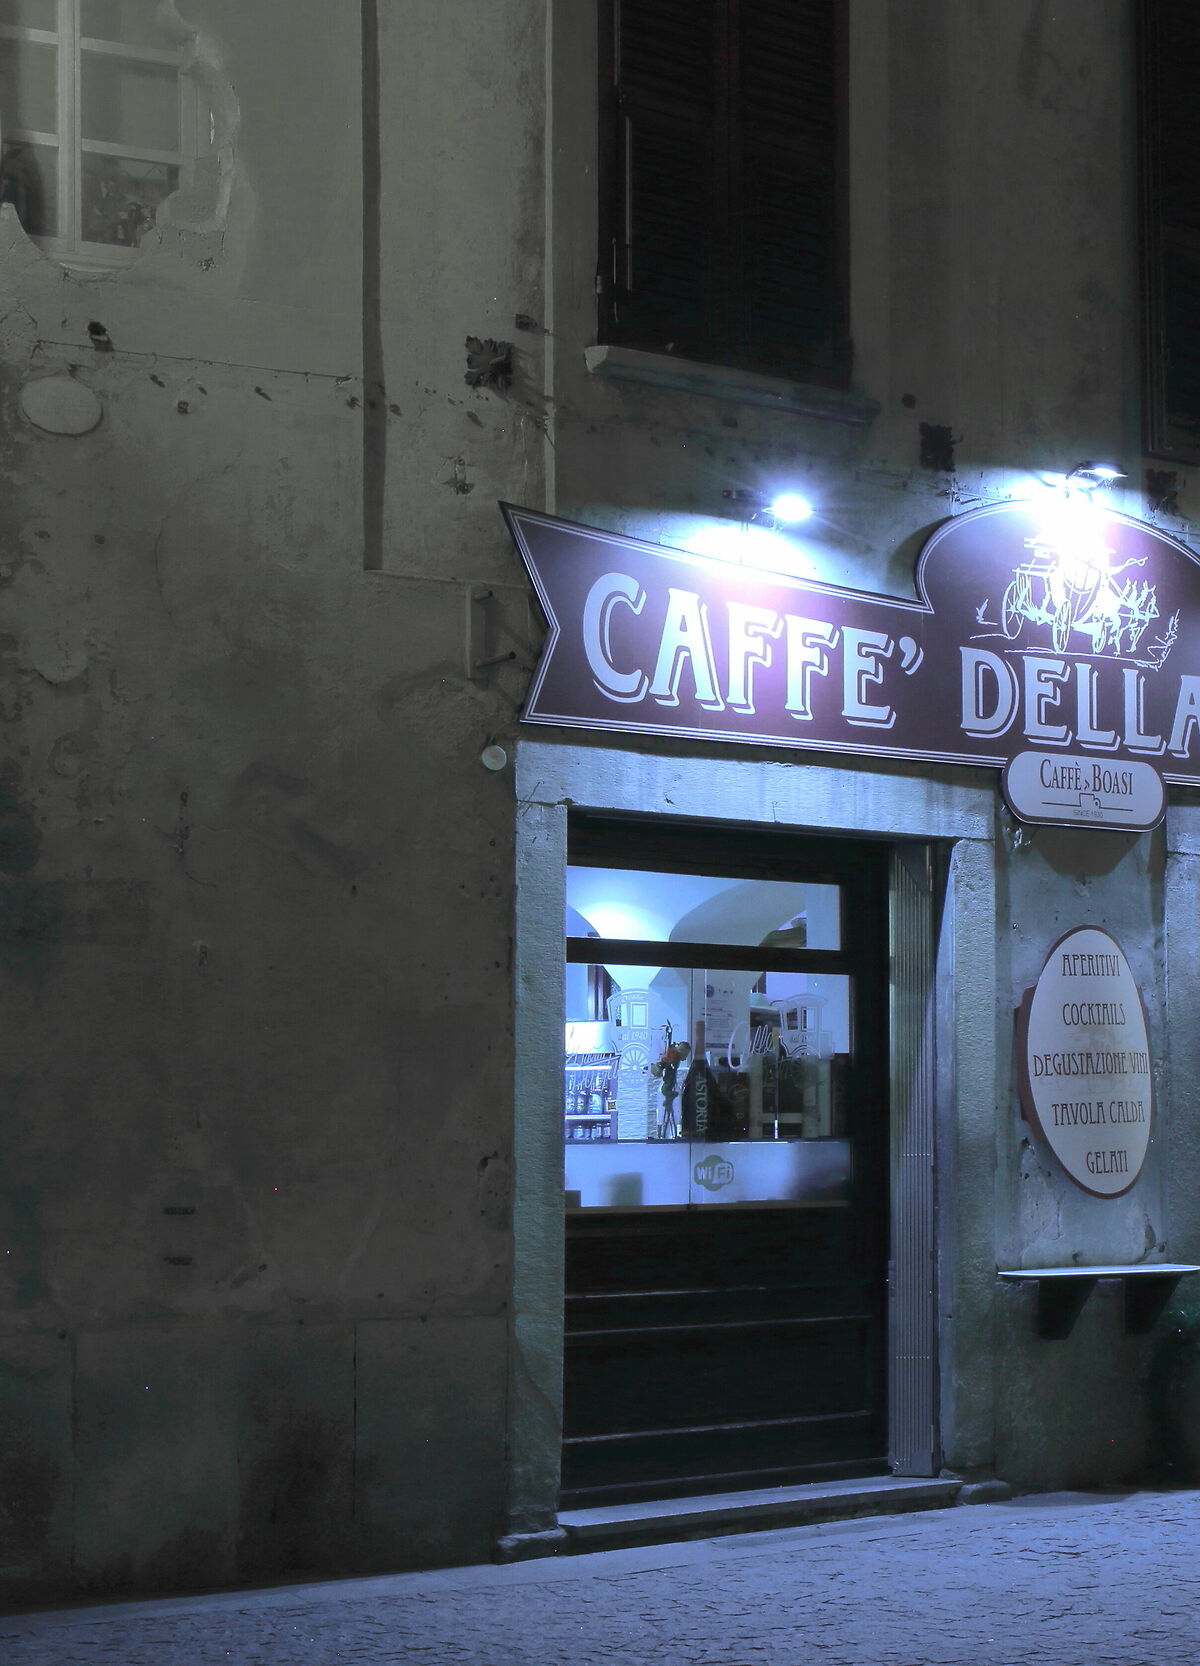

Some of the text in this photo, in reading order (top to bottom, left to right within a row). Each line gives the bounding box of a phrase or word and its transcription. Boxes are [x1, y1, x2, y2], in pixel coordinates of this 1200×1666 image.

[583, 572, 923, 728] CAFFE'
[1040, 759, 1133, 796] CAFFÈ BOASI
[1062, 954, 1121, 977] APERITIVI
[1062, 1003, 1126, 1026] COCKTAILS
[1033, 1052, 1149, 1077] DEGUSTAZIONE VINI
[1052, 1101, 1146, 1126] TAVOLA CALDA
[1086, 1150, 1129, 1174] GELATI
